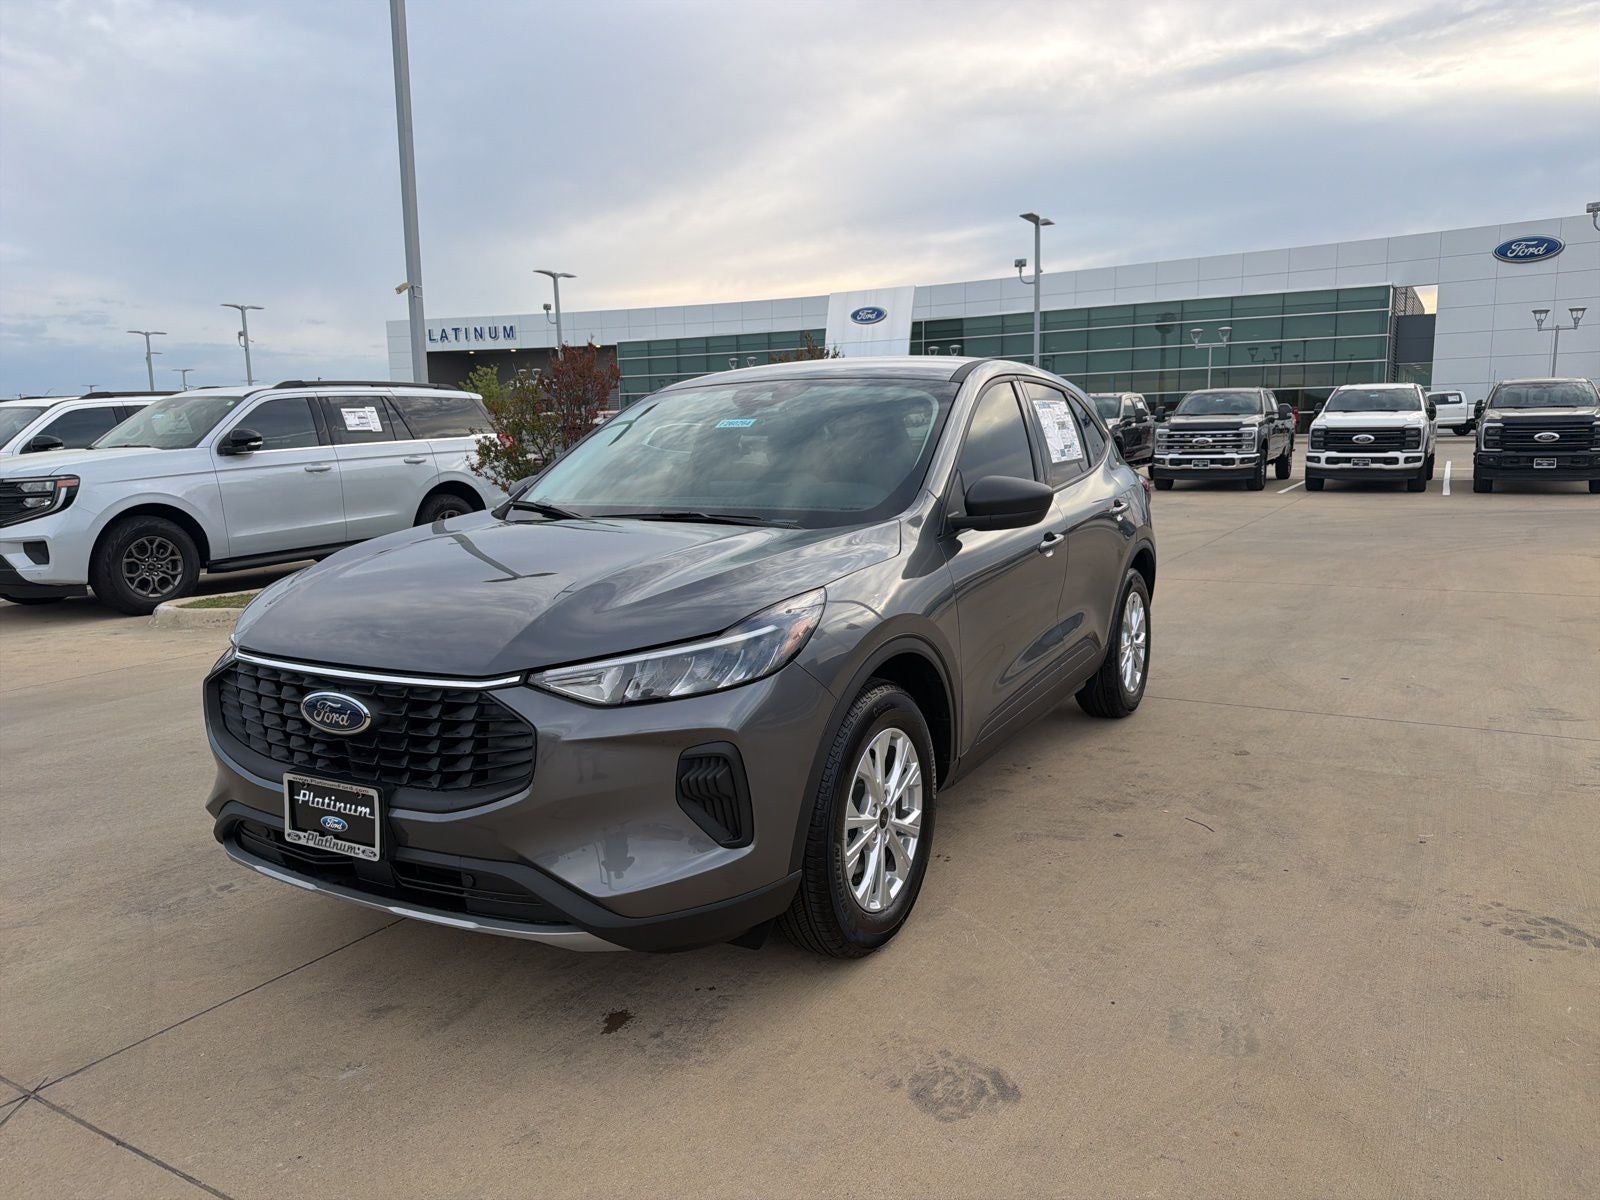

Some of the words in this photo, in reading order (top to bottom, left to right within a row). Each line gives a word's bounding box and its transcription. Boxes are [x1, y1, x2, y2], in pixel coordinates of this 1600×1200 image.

[1507, 241, 1548, 257] Ford
[856, 309, 877, 320] Ford
[428, 325, 515, 342] LATINUM
[313, 701, 351, 726] Ford
[294, 790, 375, 818] Platinum
[325, 818, 343, 829] Ford
[306, 831, 361, 855] Platinum
